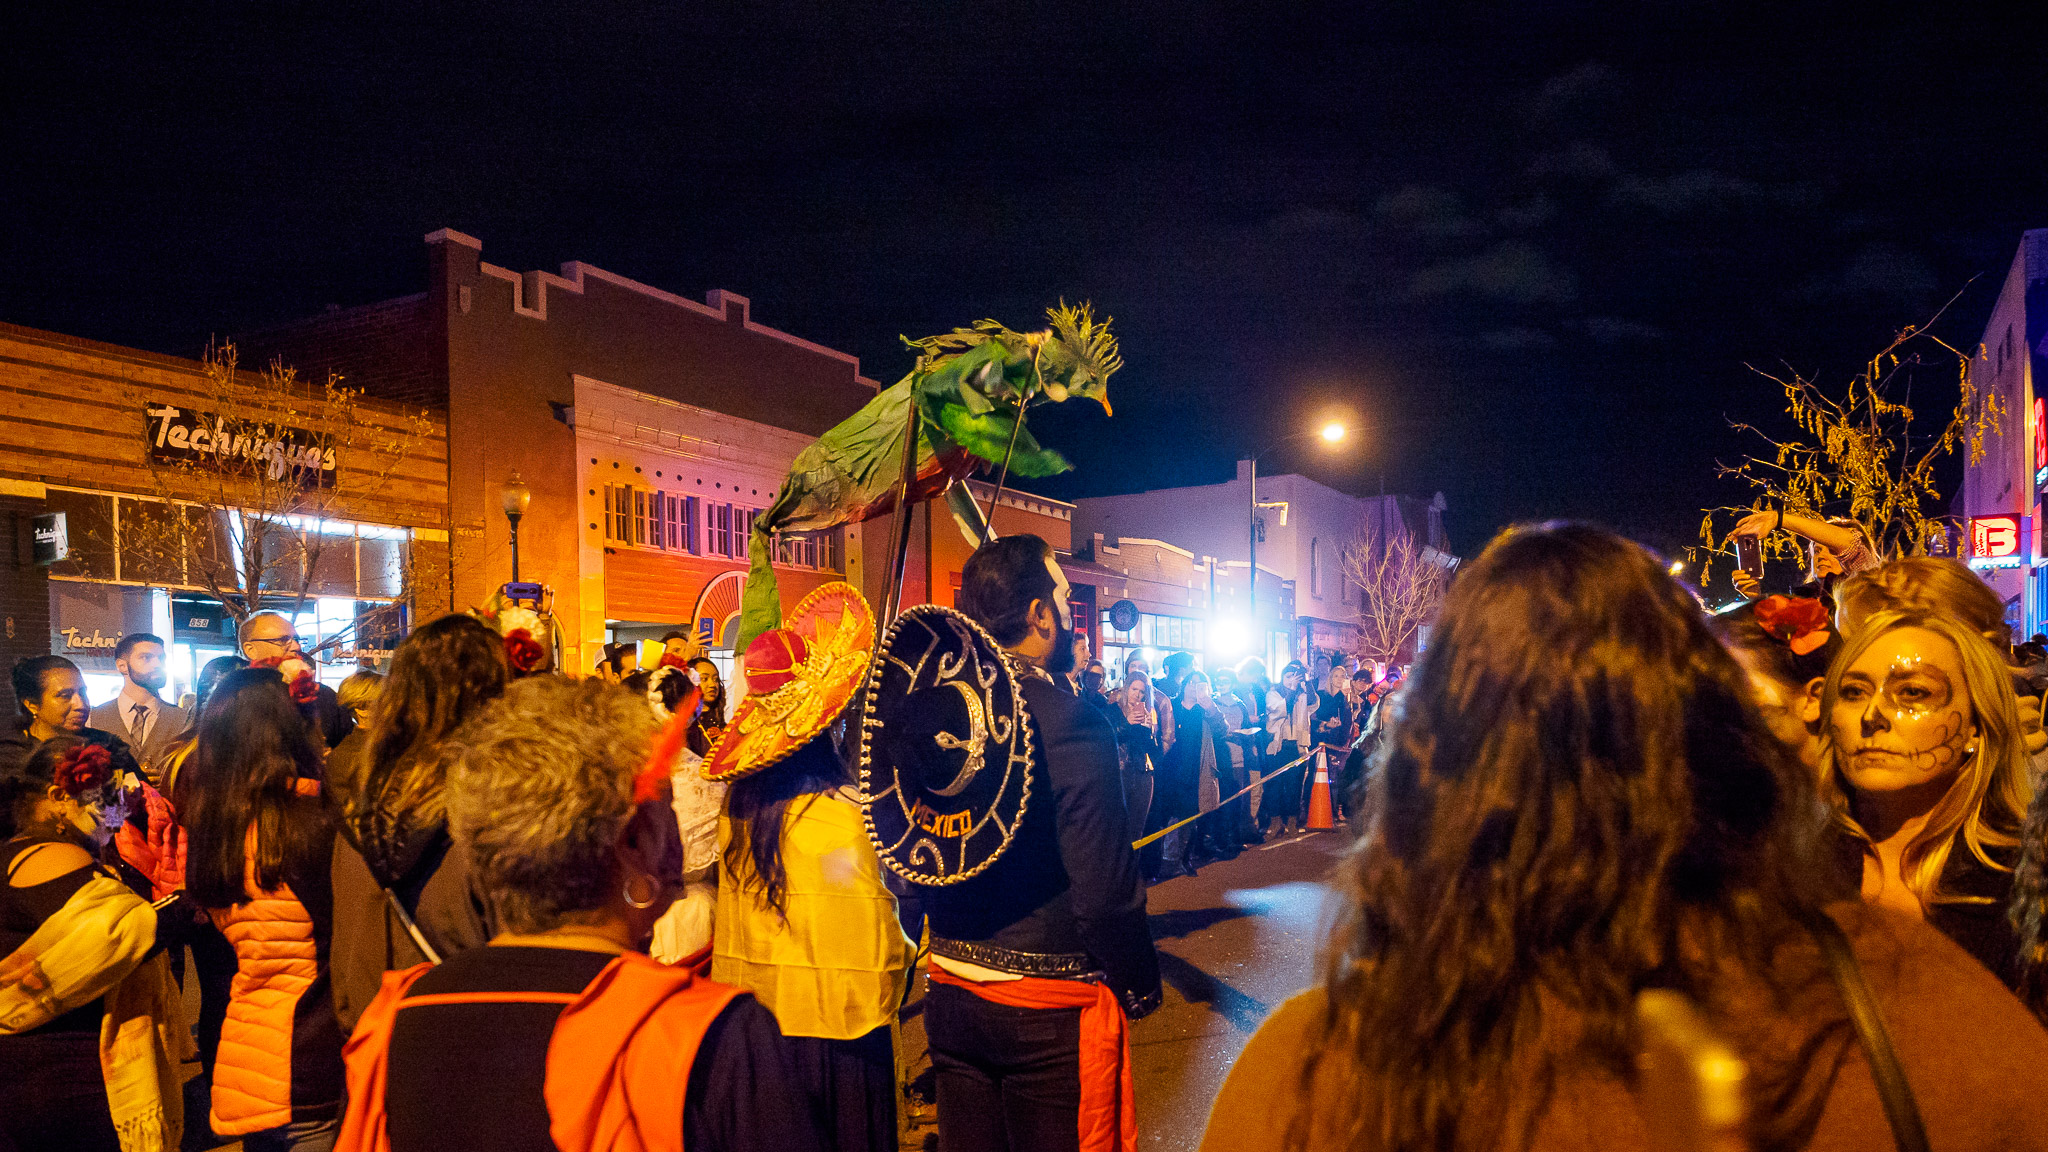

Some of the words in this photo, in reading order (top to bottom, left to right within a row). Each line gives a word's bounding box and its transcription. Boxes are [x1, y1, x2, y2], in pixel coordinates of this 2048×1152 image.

[147, 404, 336, 481] Techniques
[189, 618, 208, 627] 858
[61, 626, 123, 649] Techni
[332, 642, 395, 666] Technique
[911, 797, 972, 838] MEXICO
